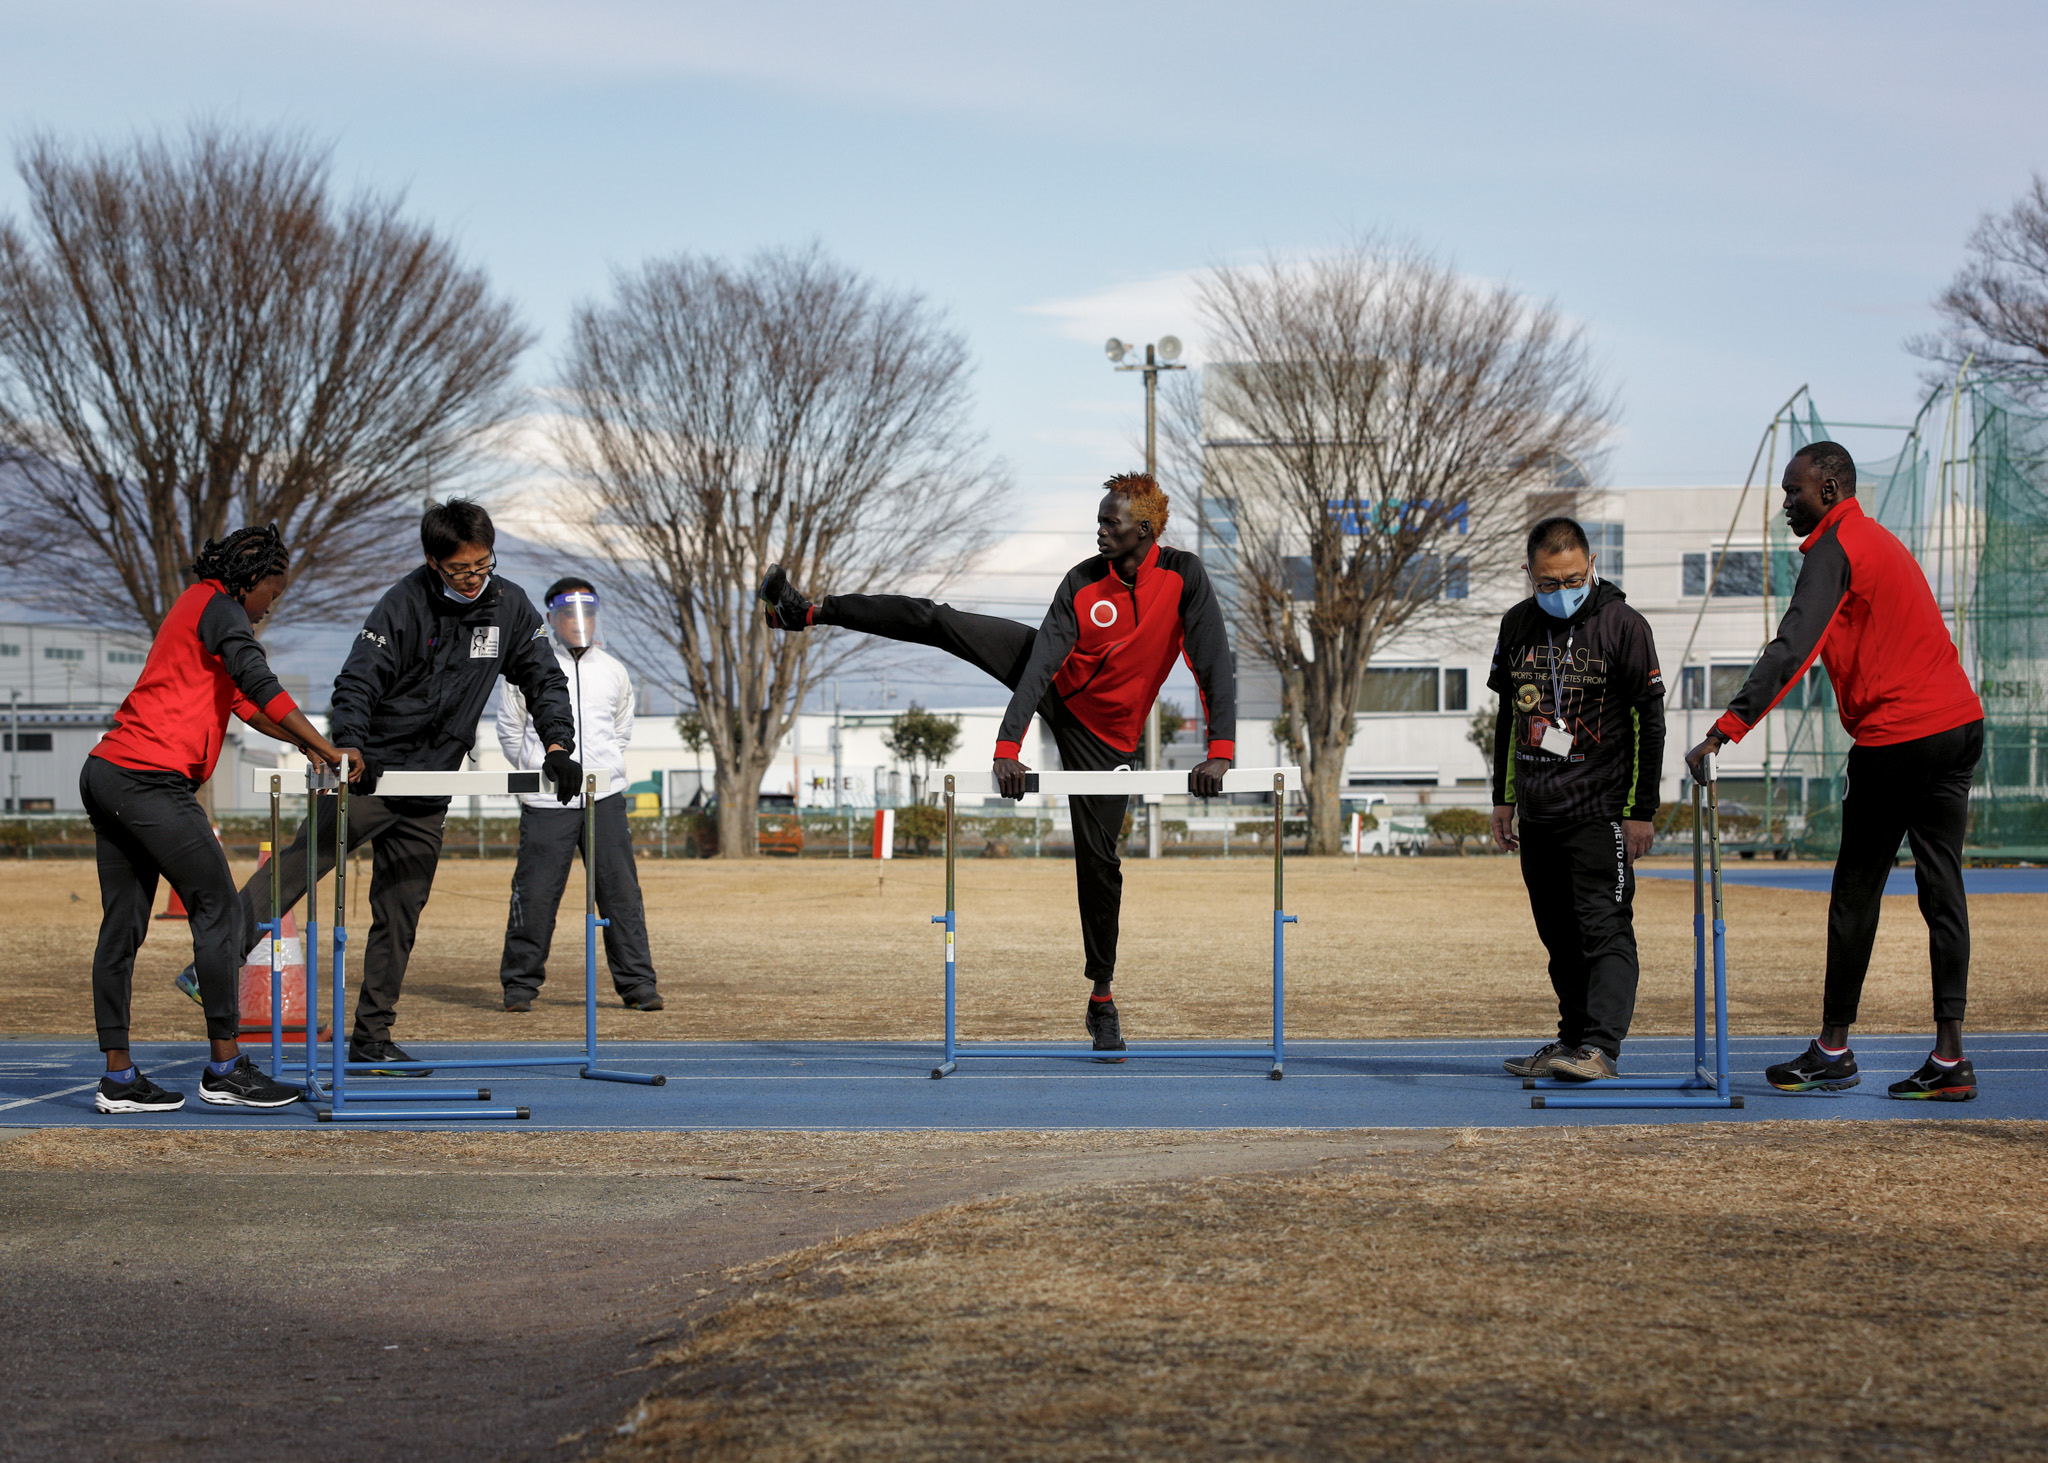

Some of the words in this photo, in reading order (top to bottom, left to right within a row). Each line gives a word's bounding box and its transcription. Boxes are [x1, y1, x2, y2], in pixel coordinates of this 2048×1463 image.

[1583, 675, 1607, 684] FROM
[1980, 681, 2029, 698] RISE
[1614, 861, 1625, 903] SPORTS
